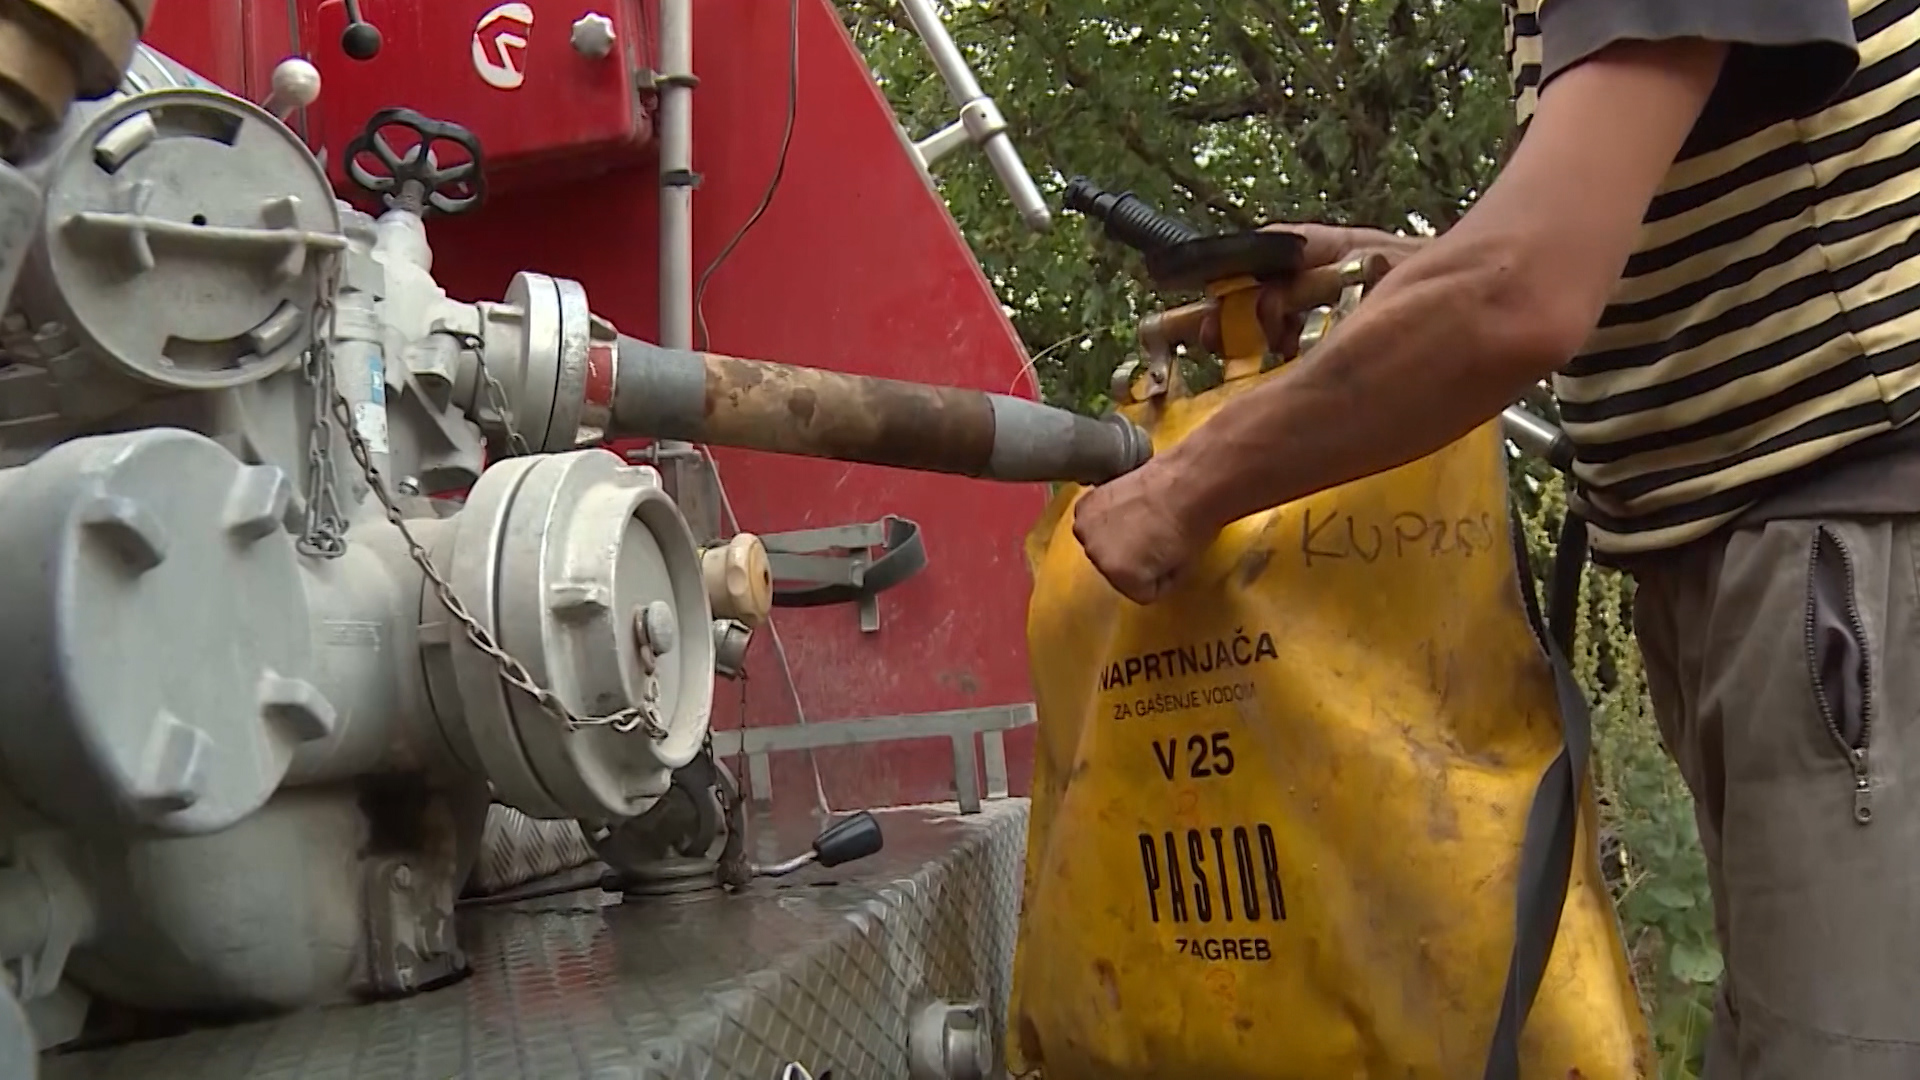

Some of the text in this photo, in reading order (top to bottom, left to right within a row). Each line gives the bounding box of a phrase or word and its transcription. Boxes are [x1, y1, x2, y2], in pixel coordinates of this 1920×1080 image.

[1114, 702, 1132, 720] ZA
[1135, 690, 1200, 717] GAŠENJE
[1152, 731, 1234, 781] V 25
[1138, 823, 1286, 922] PASTOR
